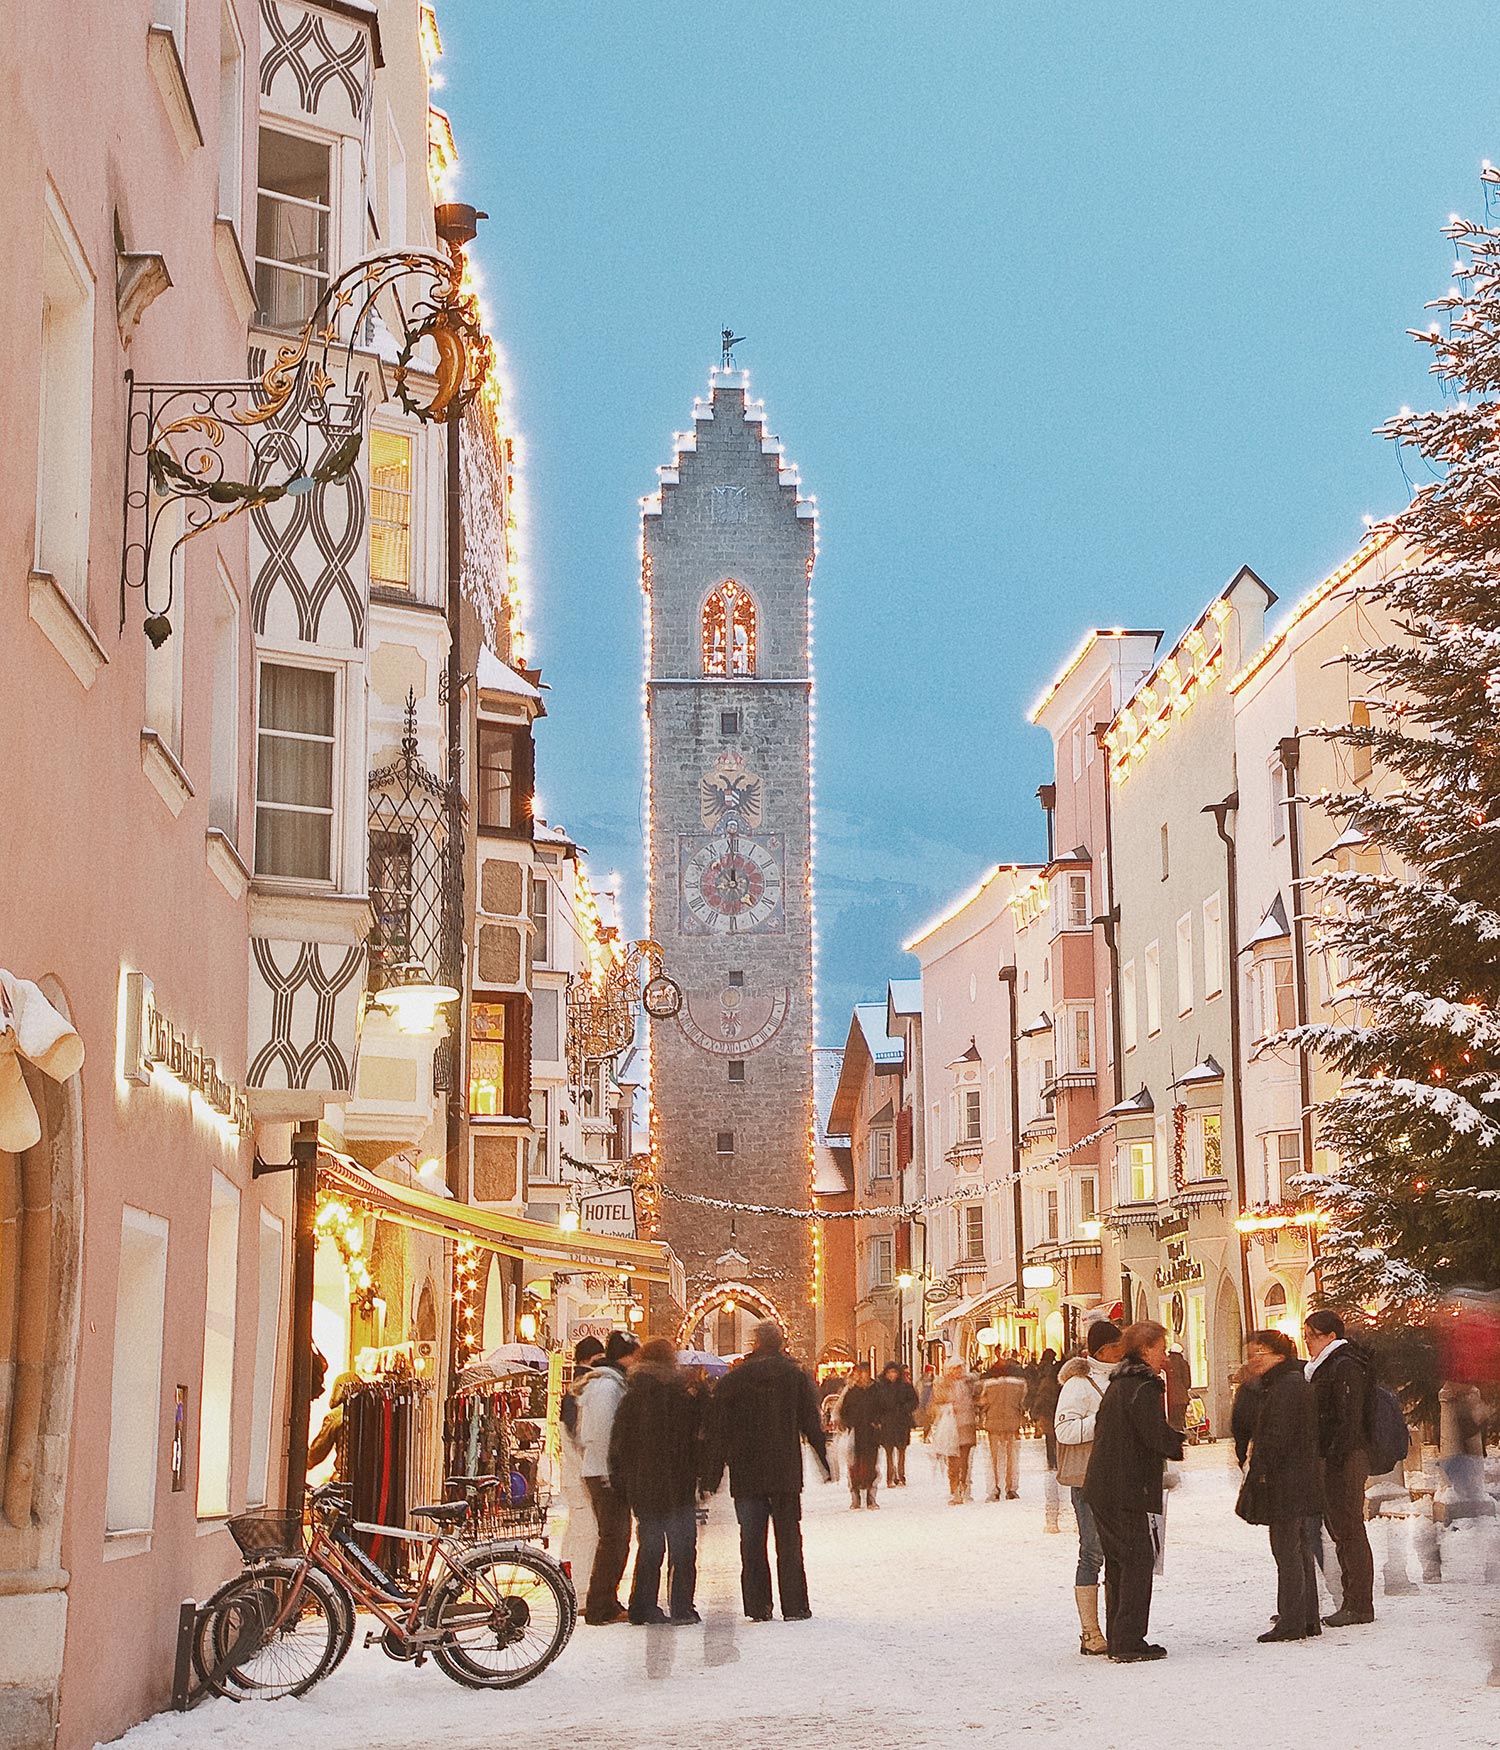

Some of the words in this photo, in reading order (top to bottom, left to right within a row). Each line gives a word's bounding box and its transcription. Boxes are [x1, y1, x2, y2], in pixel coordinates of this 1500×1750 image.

[748, 844, 756, 857] I
[761, 858, 774, 869] II
[766, 879, 780, 888] III
[749, 911, 759, 924] V
[585, 1204, 632, 1220] HOTEL
